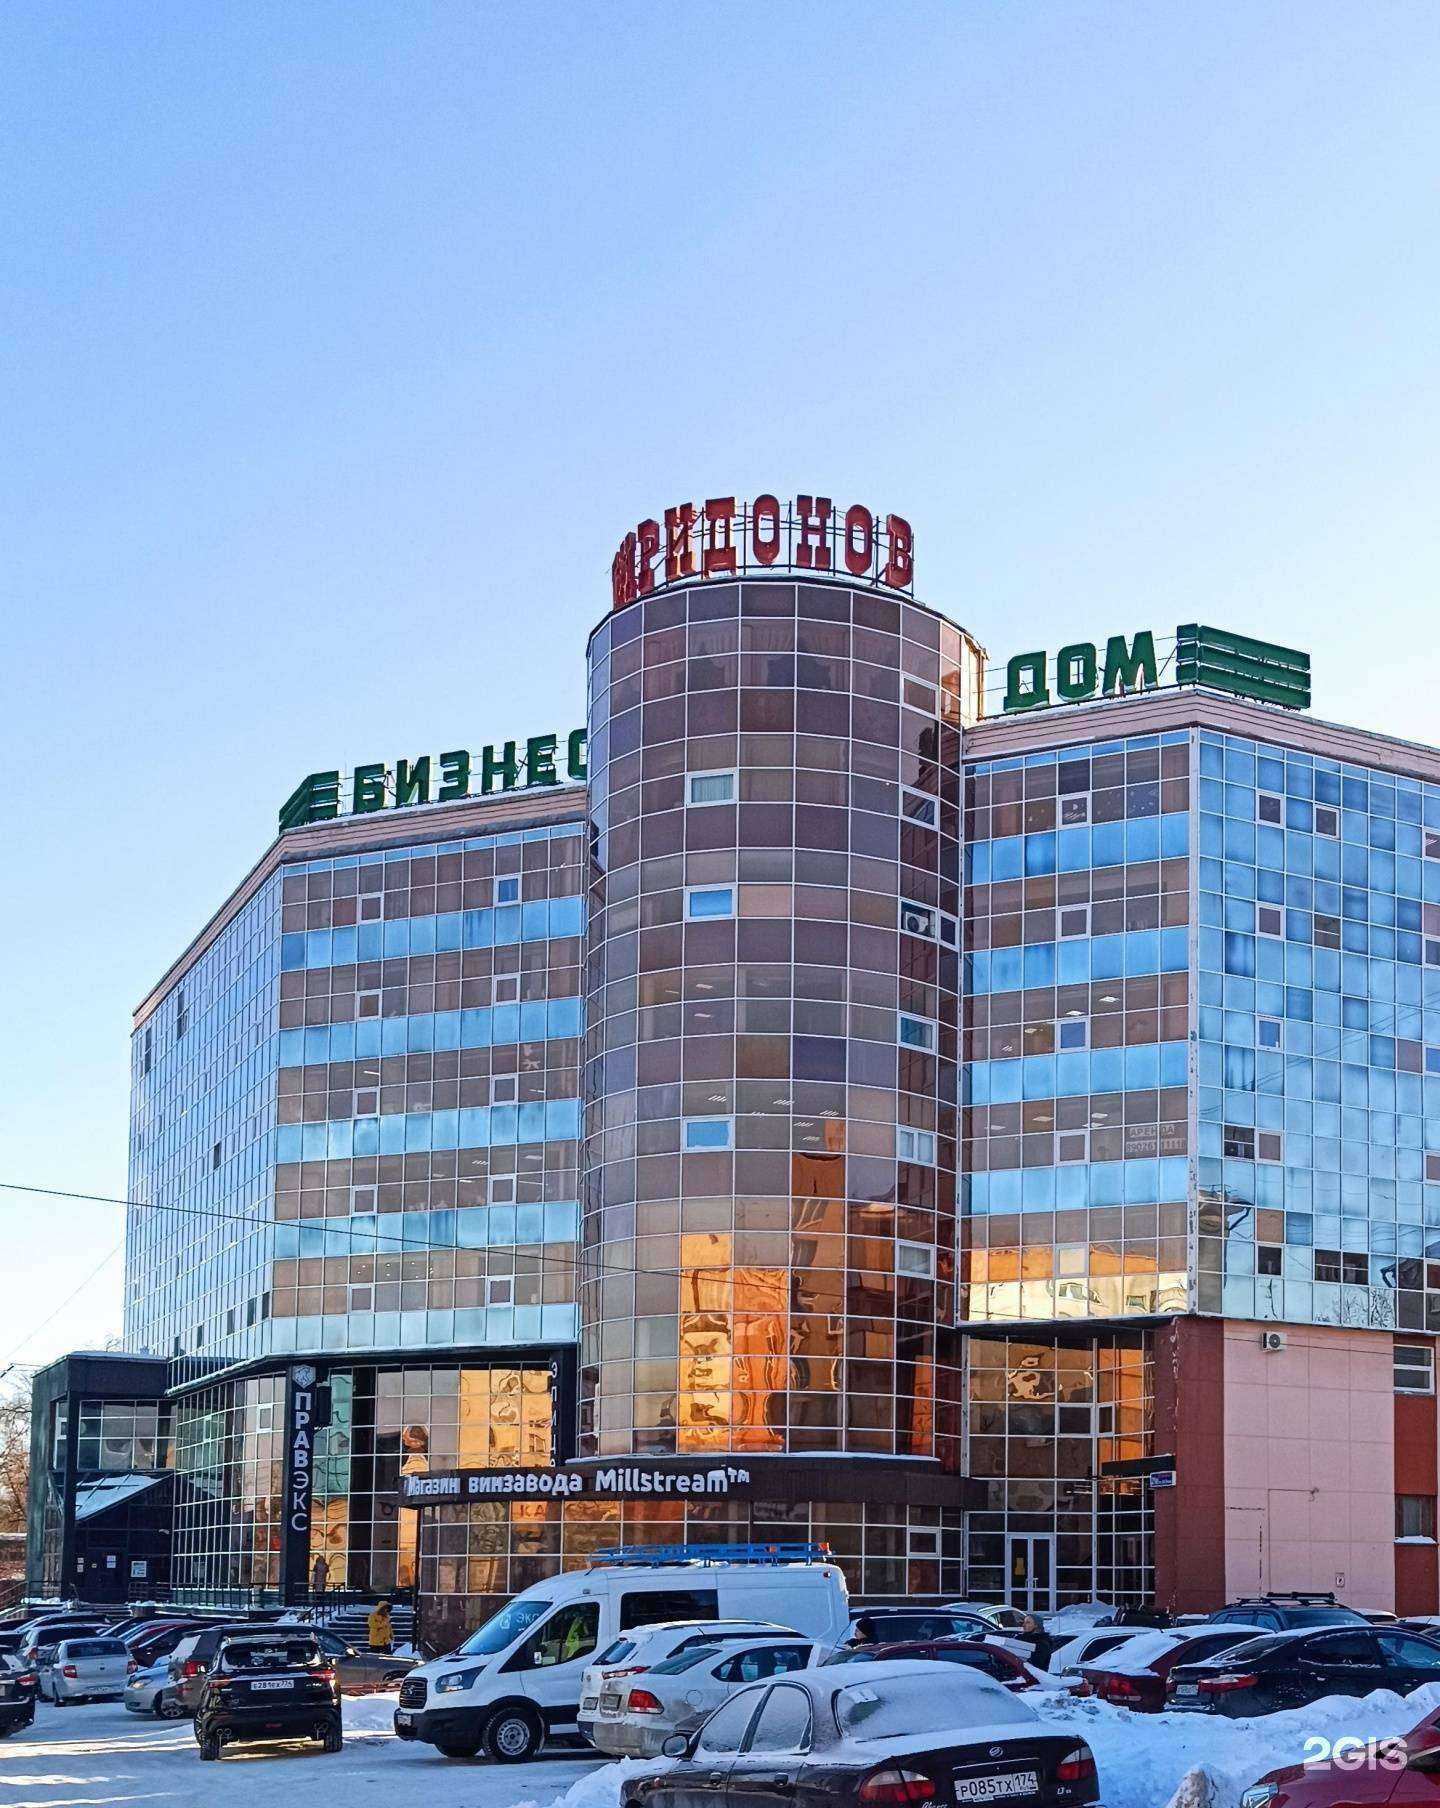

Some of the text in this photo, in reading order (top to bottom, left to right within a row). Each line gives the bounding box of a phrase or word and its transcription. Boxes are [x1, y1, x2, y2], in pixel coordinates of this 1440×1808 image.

[1003, 631, 1159, 712] ДОМ
[291, 1392, 313, 1531] ПРАВЭКС
[405, 1476, 461, 1497] Магазин
[468, 1473, 584, 1496] винзавода
